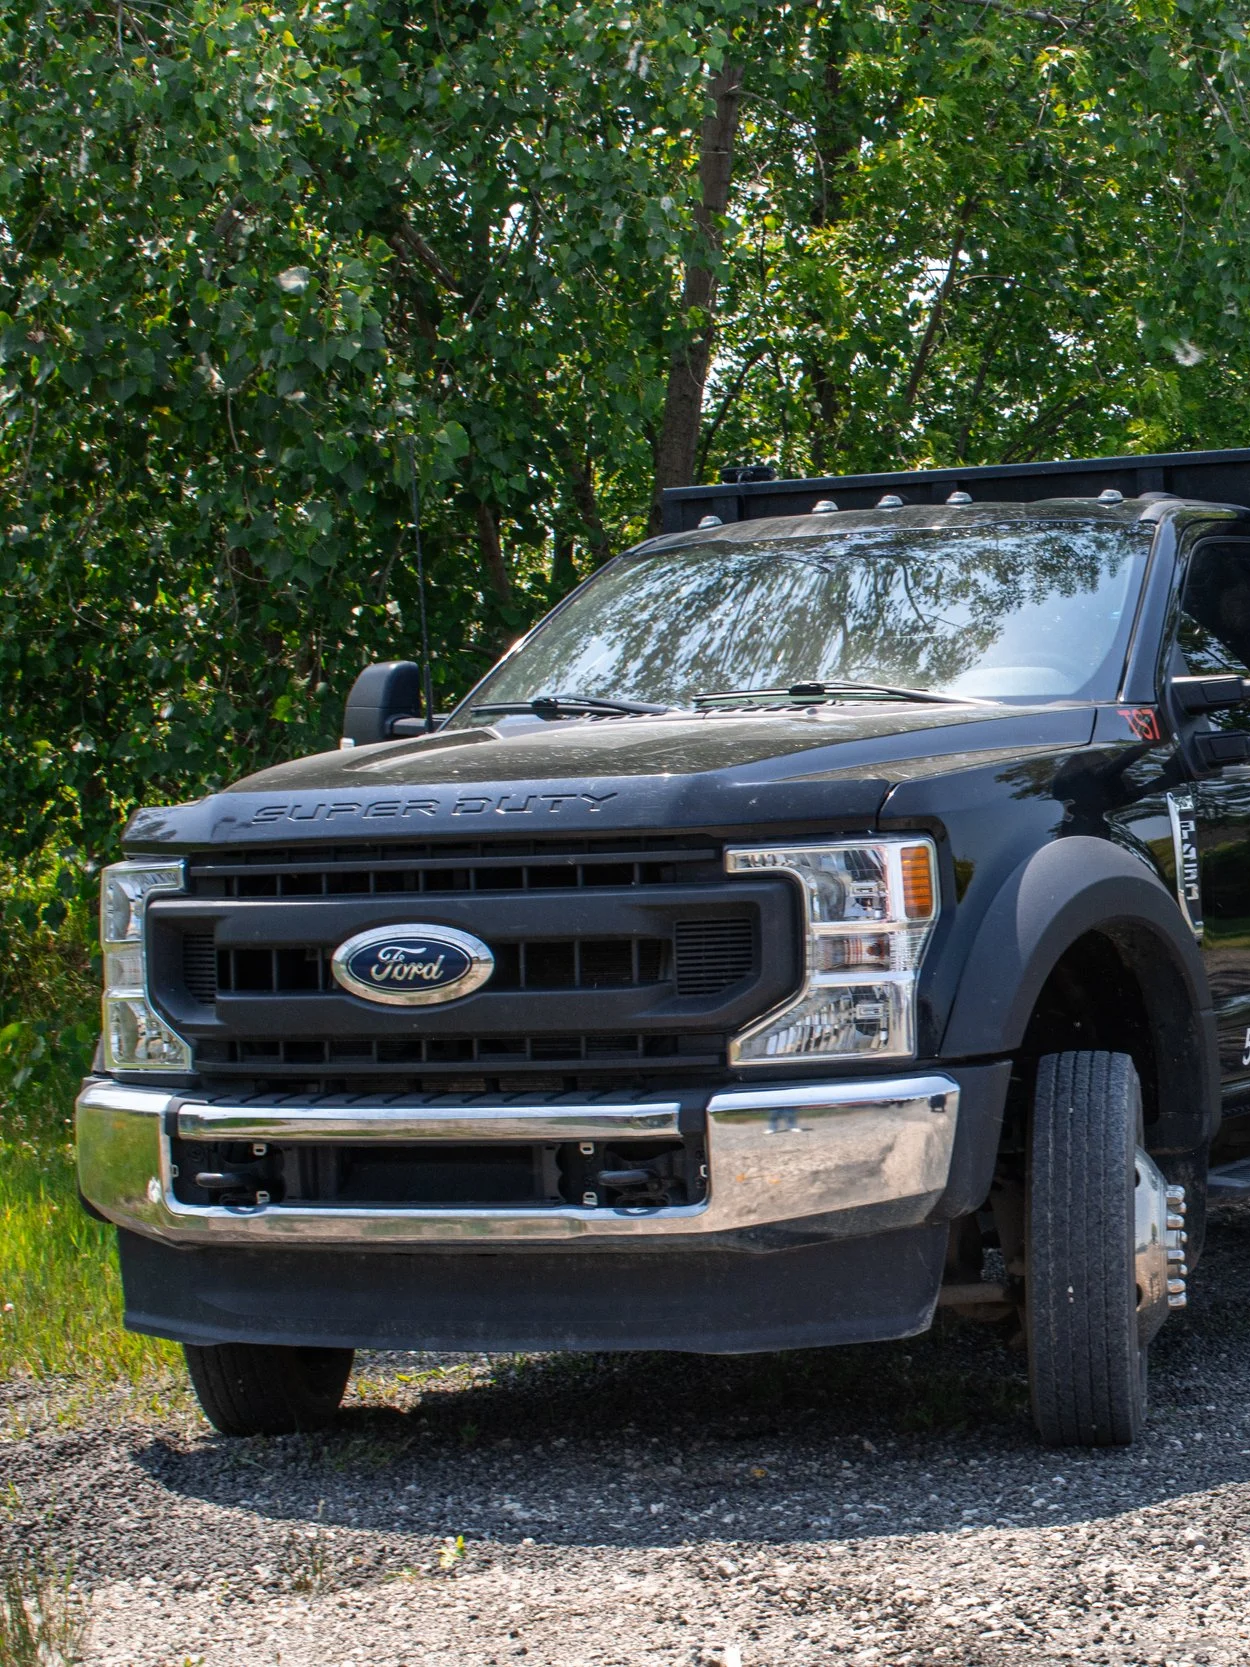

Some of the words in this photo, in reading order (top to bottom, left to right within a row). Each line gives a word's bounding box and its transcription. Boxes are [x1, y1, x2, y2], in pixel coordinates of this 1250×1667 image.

[251, 798, 441, 825] SUPER
[451, 792, 619, 816] DUTY
[370, 946, 444, 982] Ford
